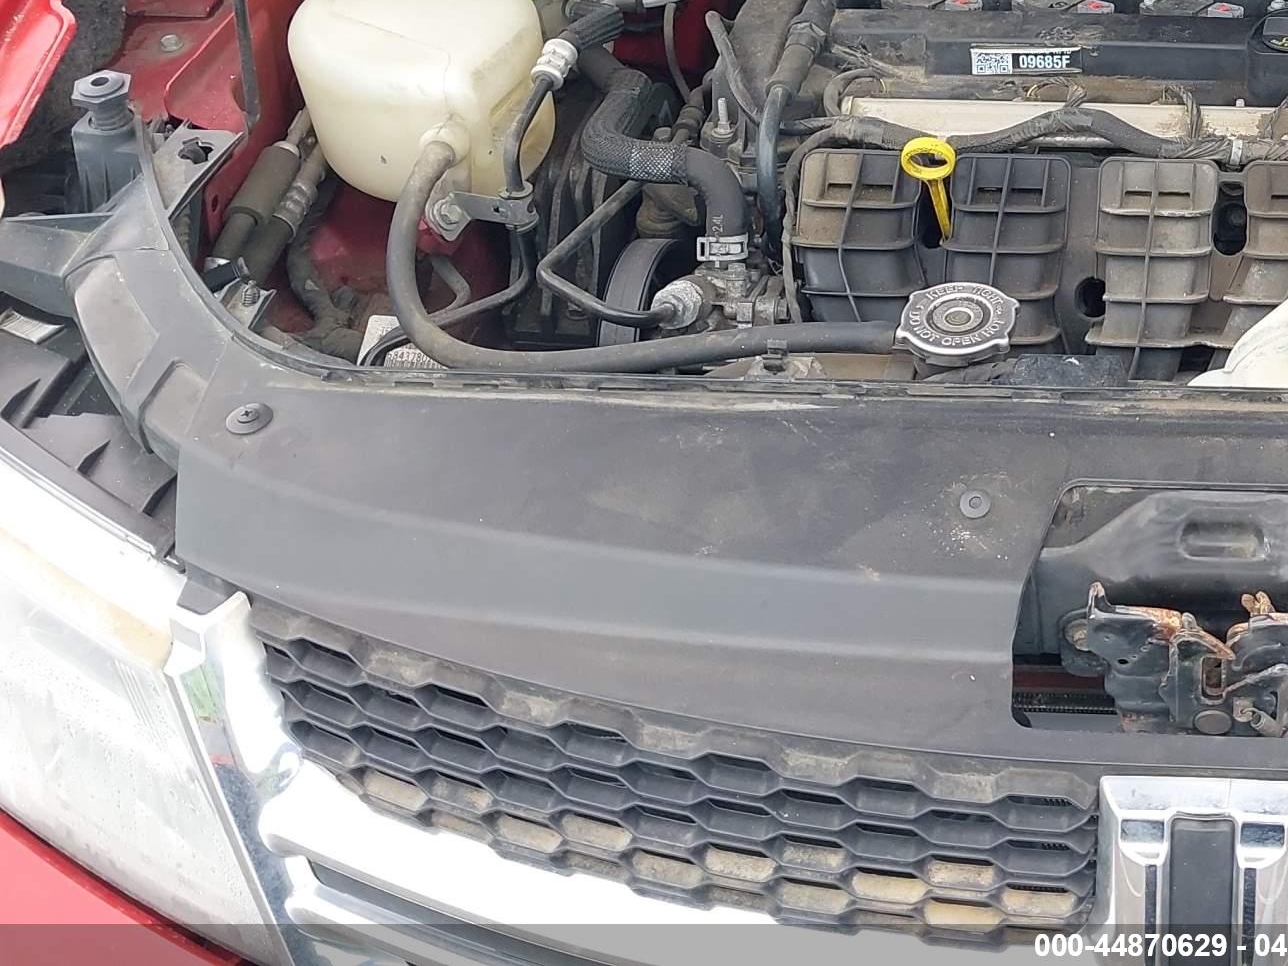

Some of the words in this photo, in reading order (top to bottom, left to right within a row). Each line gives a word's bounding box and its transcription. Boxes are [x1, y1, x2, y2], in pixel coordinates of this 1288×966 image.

[1019, 55, 1071, 69] 09685F
[926, 286, 965, 300] KEEP
[972, 286, 1004, 305] TIGHT
[912, 326, 940, 342] NOT
[941, 335, 982, 347] OPEN
[981, 319, 1005, 338] HOT
